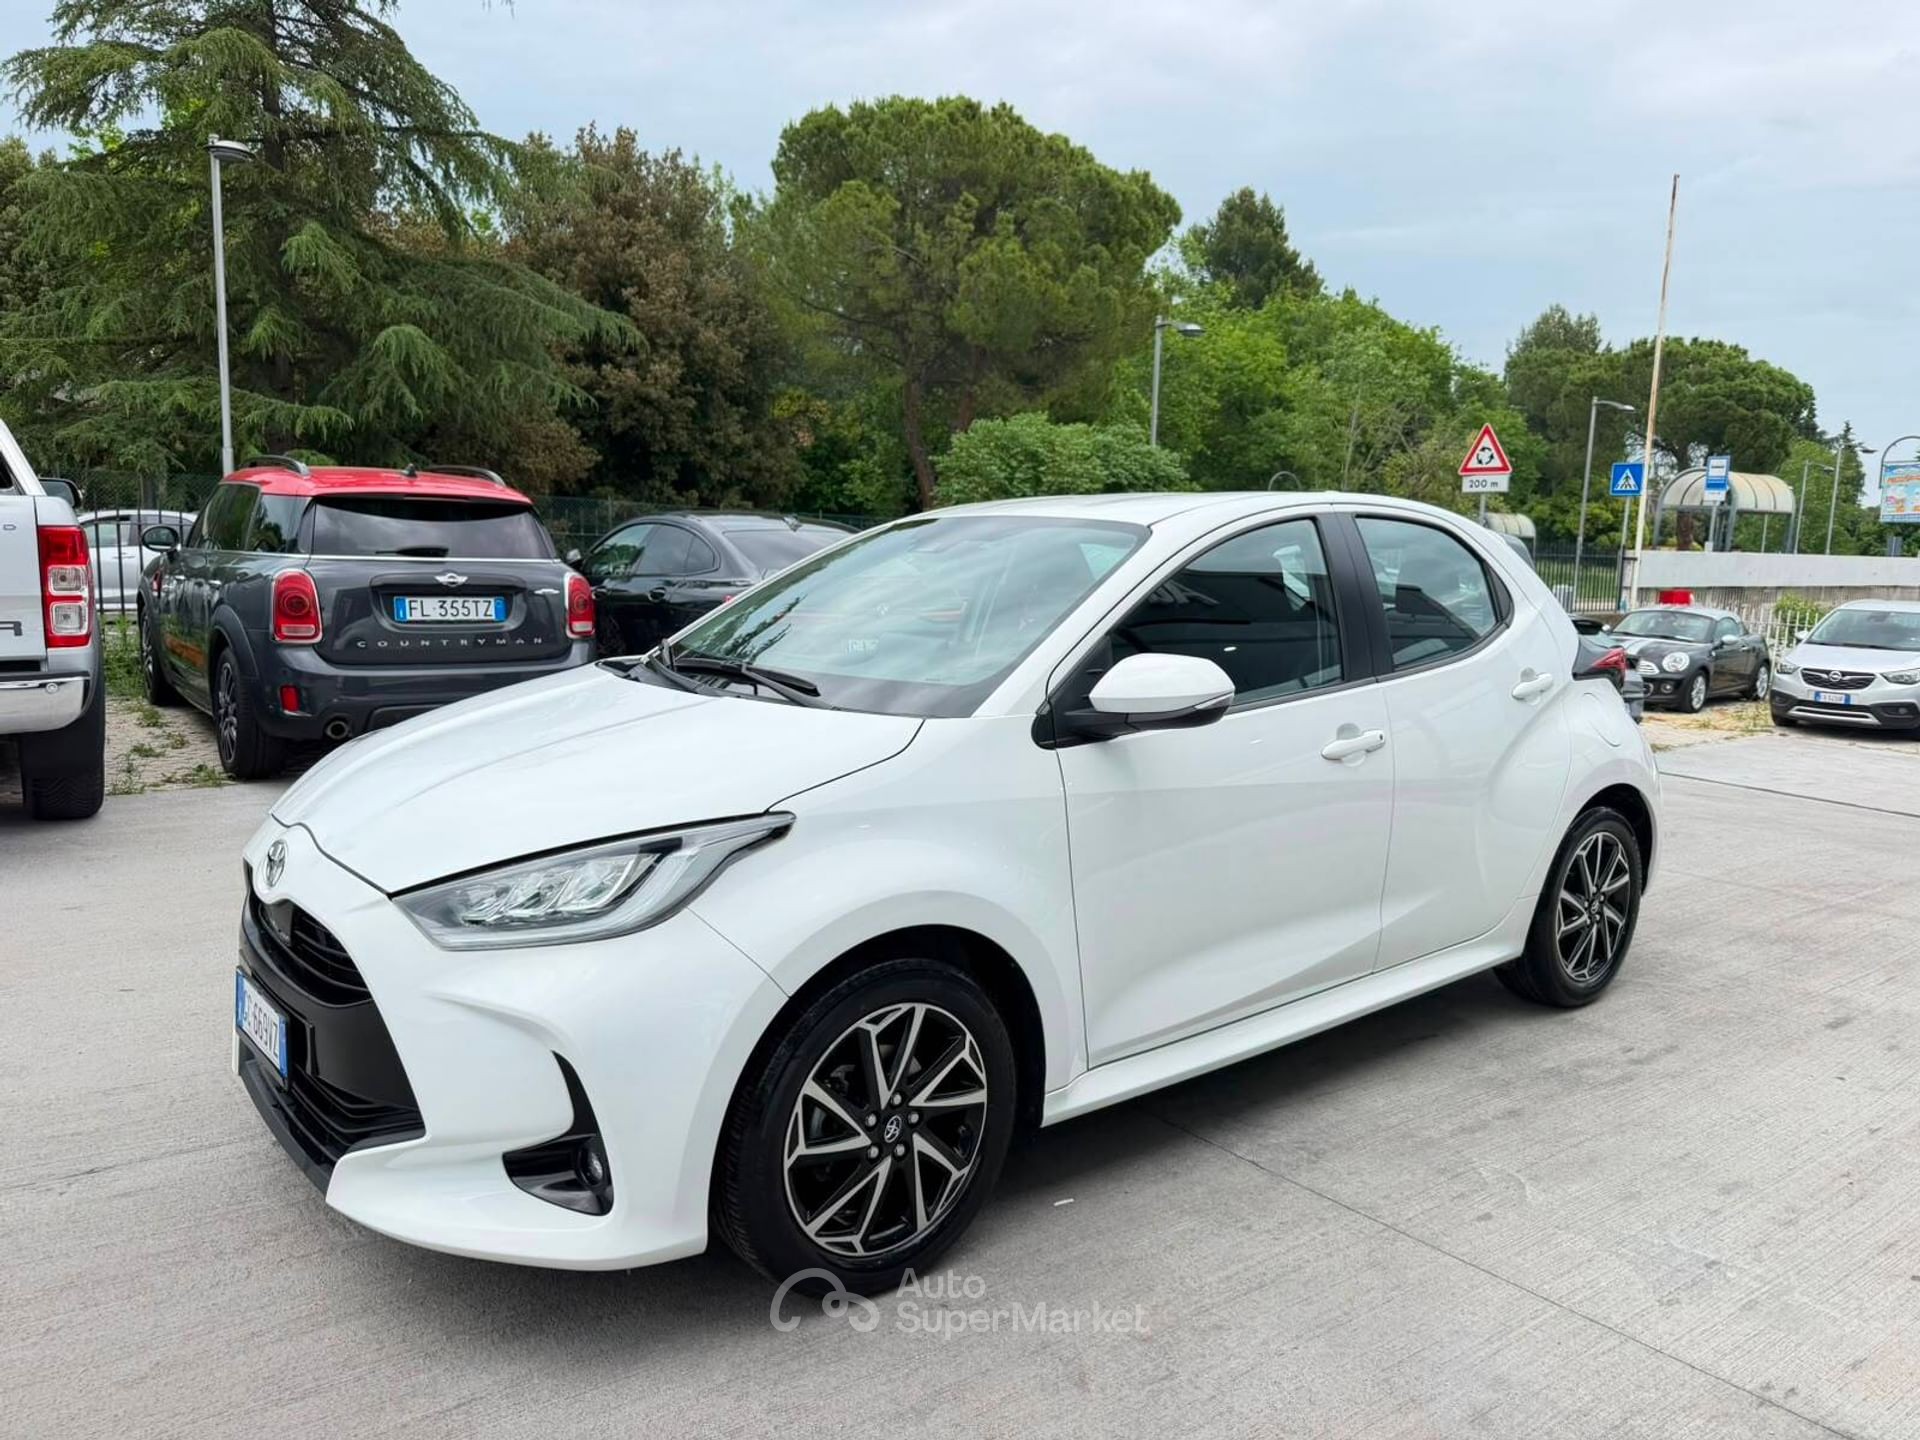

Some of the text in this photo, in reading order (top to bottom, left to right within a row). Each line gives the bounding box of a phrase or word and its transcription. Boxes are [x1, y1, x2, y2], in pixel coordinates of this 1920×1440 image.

[1469, 479, 1488, 489] 200
[408, 599, 493, 617] FL 355TZ
[356, 638, 543, 648] COUNTRYMAN
